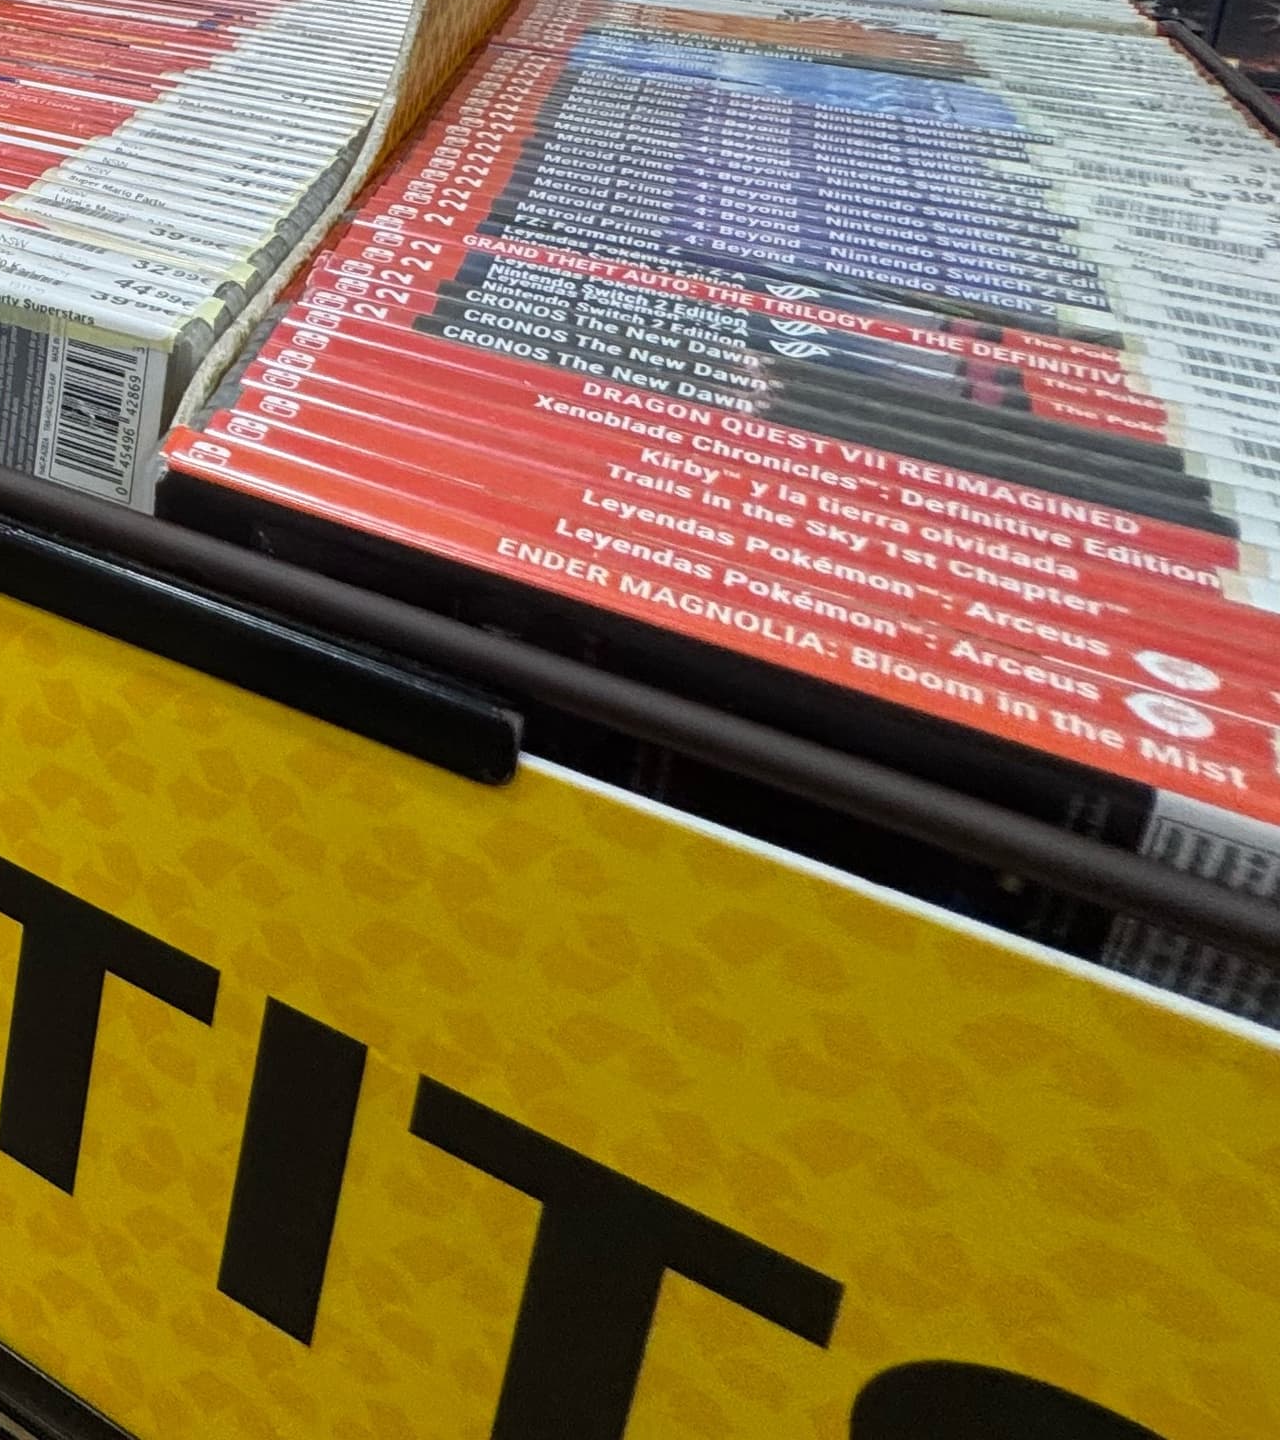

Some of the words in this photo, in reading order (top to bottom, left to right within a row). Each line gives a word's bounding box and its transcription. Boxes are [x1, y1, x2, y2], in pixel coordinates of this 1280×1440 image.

[23, 297, 96, 326] Superstars
[461, 234, 541, 267] GRAND
[545, 249, 616, 278] THEFT
[622, 266, 699, 297] AUTO:
[706, 285, 754, 308] THE
[759, 297, 884, 332] TRILOGY
[909, 328, 968, 352] THE
[515, 200, 596, 226] Metroid
[709, 238, 797, 266] Beyond
[824, 260, 937, 293] Nintendo
[943, 284, 1034, 312] Switch
[1041, 302, 1058, 316] 2
[442, 324, 550, 362] CRONOS
[557, 350, 605, 377] The
[611, 365, 671, 392] New
[535, 393, 684, 445] Xenoblade
[900, 485, 1074, 549] Definitive
[1083, 536, 1223, 589] Edition
[582, 381, 712, 426] DRAGON
[721, 416, 830, 455] QUEST
[839, 445, 887, 471] VII
[897, 459, 1140, 536] REIMAGINED
[606, 461, 692, 499] Trails
[702, 489, 732, 511] in
[741, 500, 795, 530] the
[805, 516, 871, 552] Sky
[880, 539, 938, 570] 1st
[582, 487, 736, 547] Leyendas
[966, 601, 1113, 658] Arceus
[778, 483, 807, 507] la
[818, 496, 910, 535] tierra
[920, 524, 1079, 581] olvidada
[496, 536, 611, 588] ENDER
[618, 574, 838, 661] MAGNOLIA:
[850, 646, 985, 706] Bloom
[995, 690, 1040, 723] in
[1049, 707, 1127, 750] the
[1138, 735, 1249, 791] Mist
